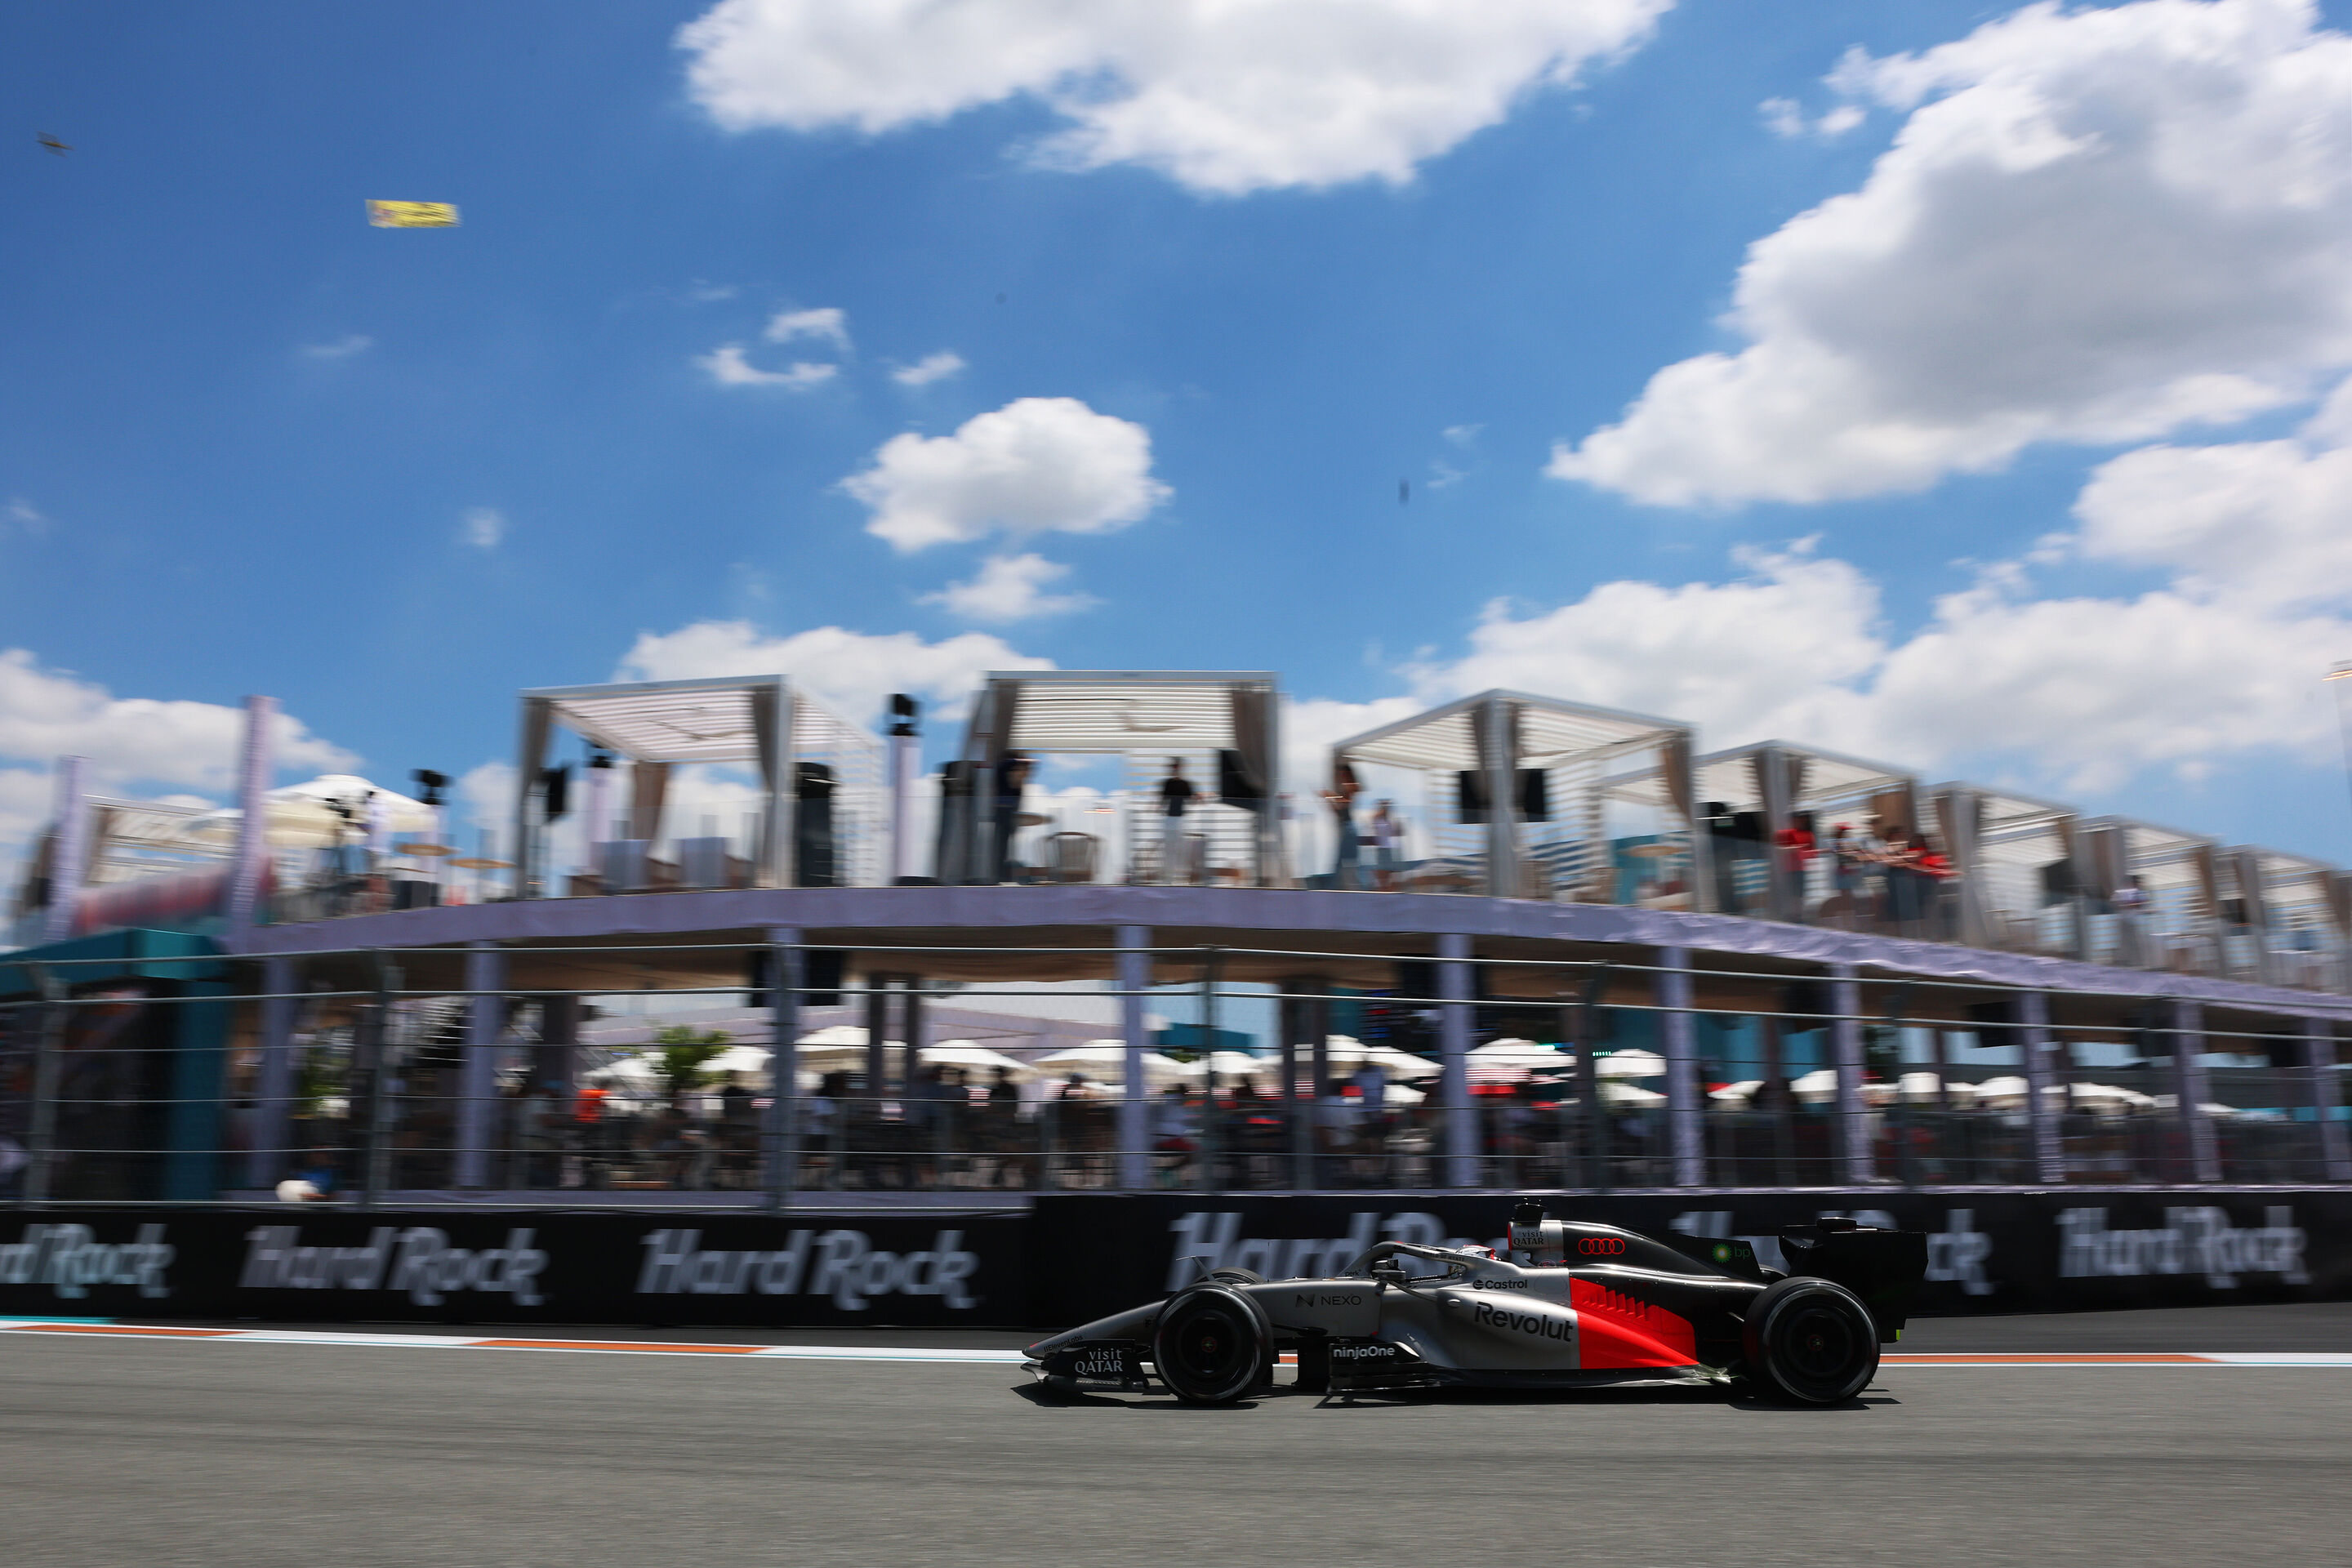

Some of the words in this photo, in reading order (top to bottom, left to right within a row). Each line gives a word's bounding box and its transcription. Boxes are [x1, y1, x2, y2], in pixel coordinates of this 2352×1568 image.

[1513, 1237, 1544, 1245] QATAR
[1734, 1246, 1751, 1260] bp
[238, 1226, 398, 1290] Hard
[385, 1227, 549, 1306] Rock
[635, 1228, 813, 1294] Hard
[807, 1229, 980, 1311] Rock
[1485, 1279, 1528, 1290] Castrol
[1321, 1295, 1361, 1306] NEXO
[1475, 1301, 1573, 1342] Revolut
[1089, 1348, 1123, 1361] visit
[1333, 1346, 1396, 1360] ninjaOne
[1075, 1360, 1123, 1375] QATAR
